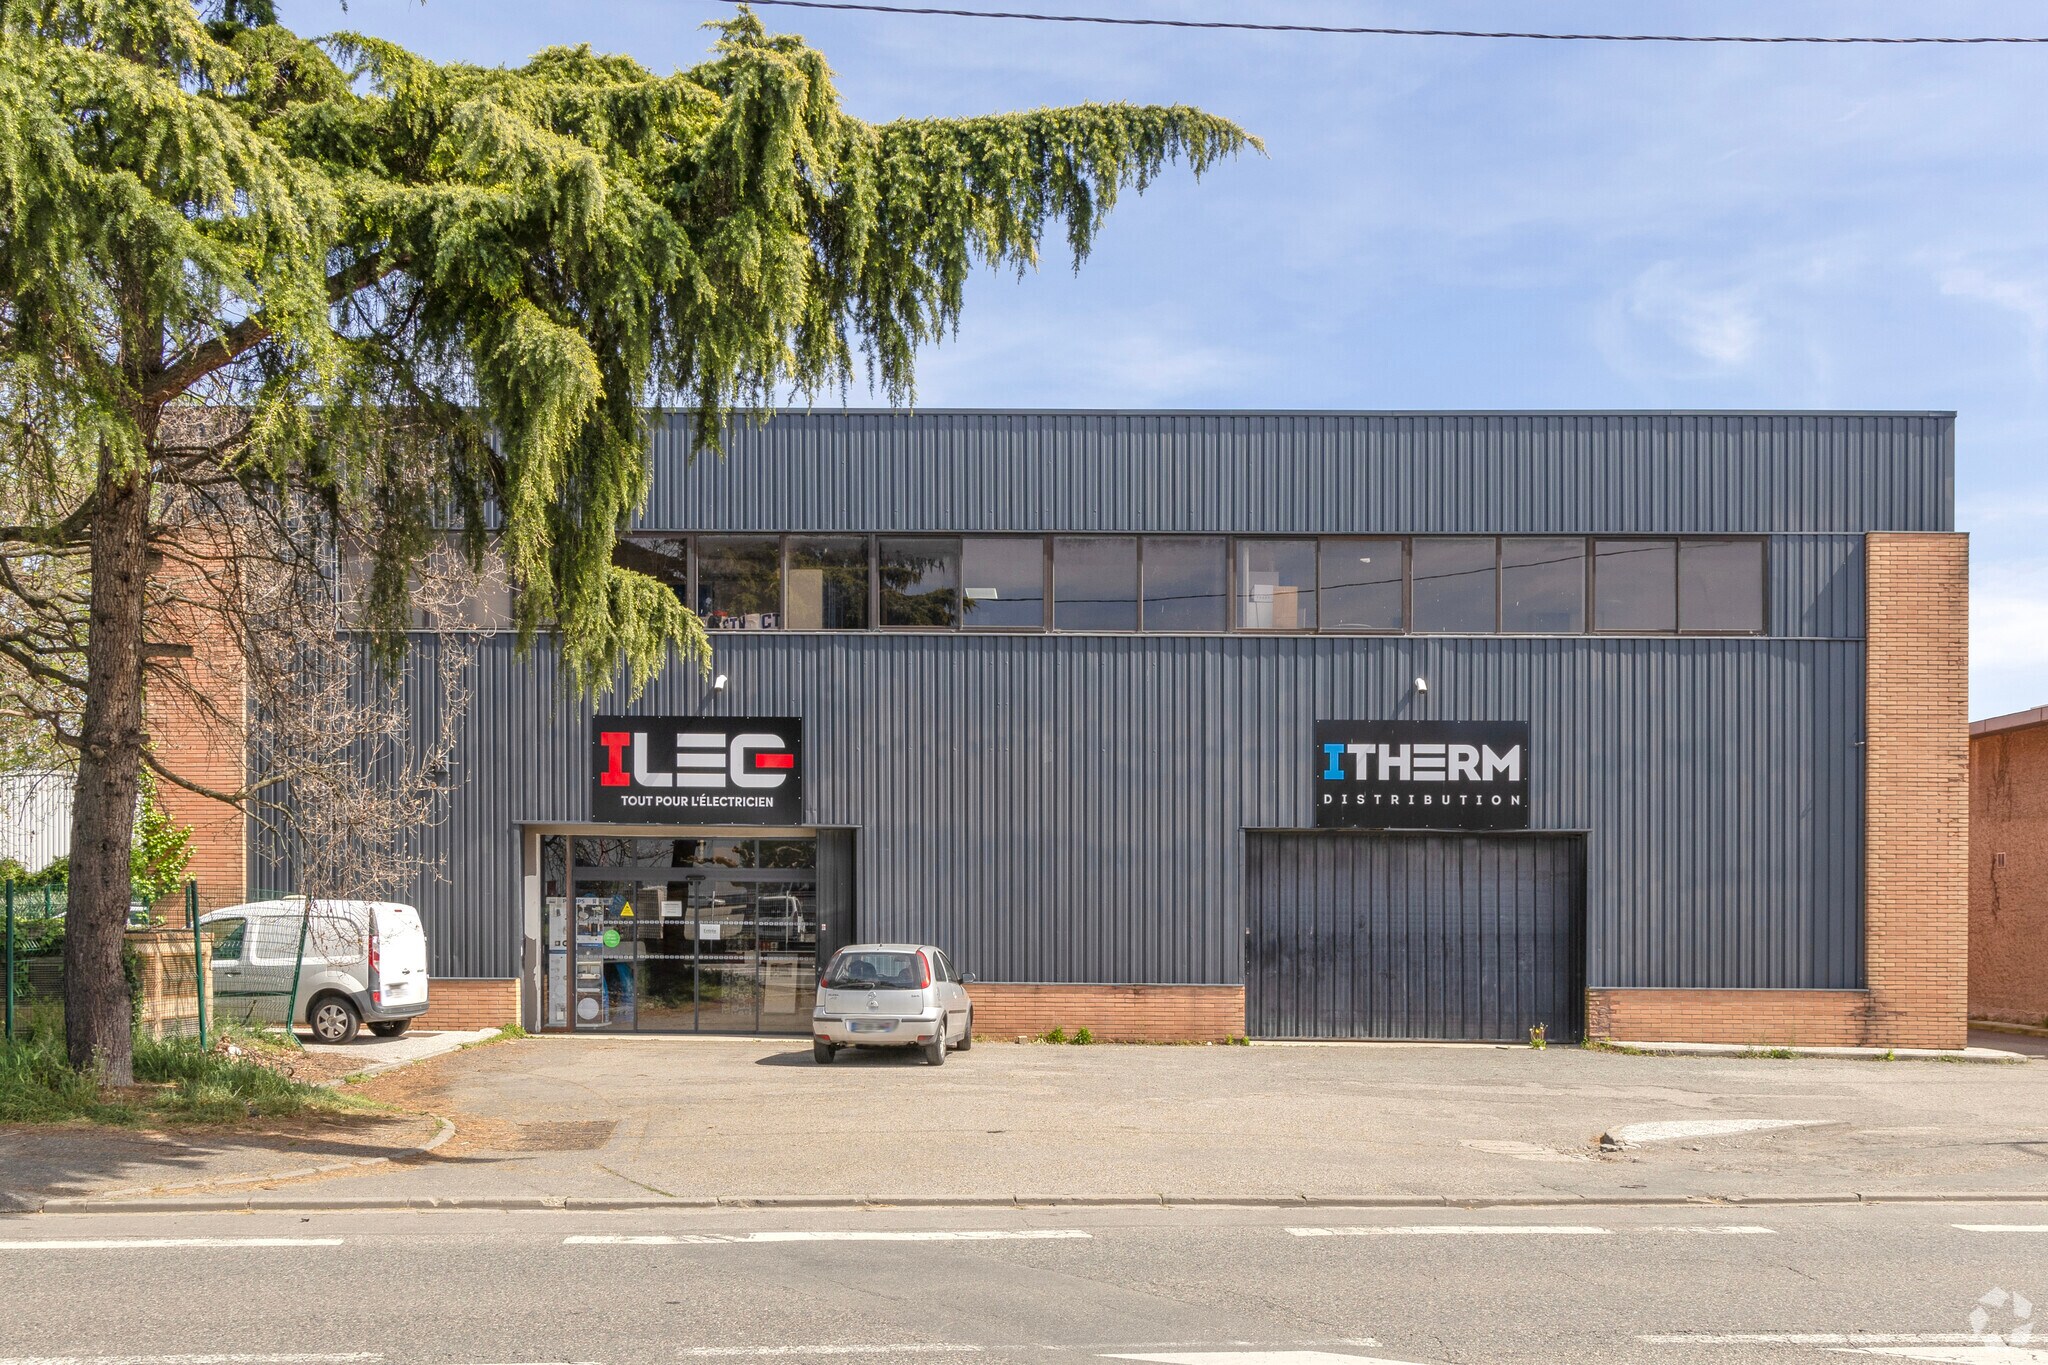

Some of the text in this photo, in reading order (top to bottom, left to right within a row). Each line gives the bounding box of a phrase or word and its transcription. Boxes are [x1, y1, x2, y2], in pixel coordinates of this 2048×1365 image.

[1323, 743, 1521, 782] ITHERM
[620, 793, 774, 808] TOUT POUR L'ÉLECTRICIEN
[1323, 794, 1521, 806] DISTRIBUTION
